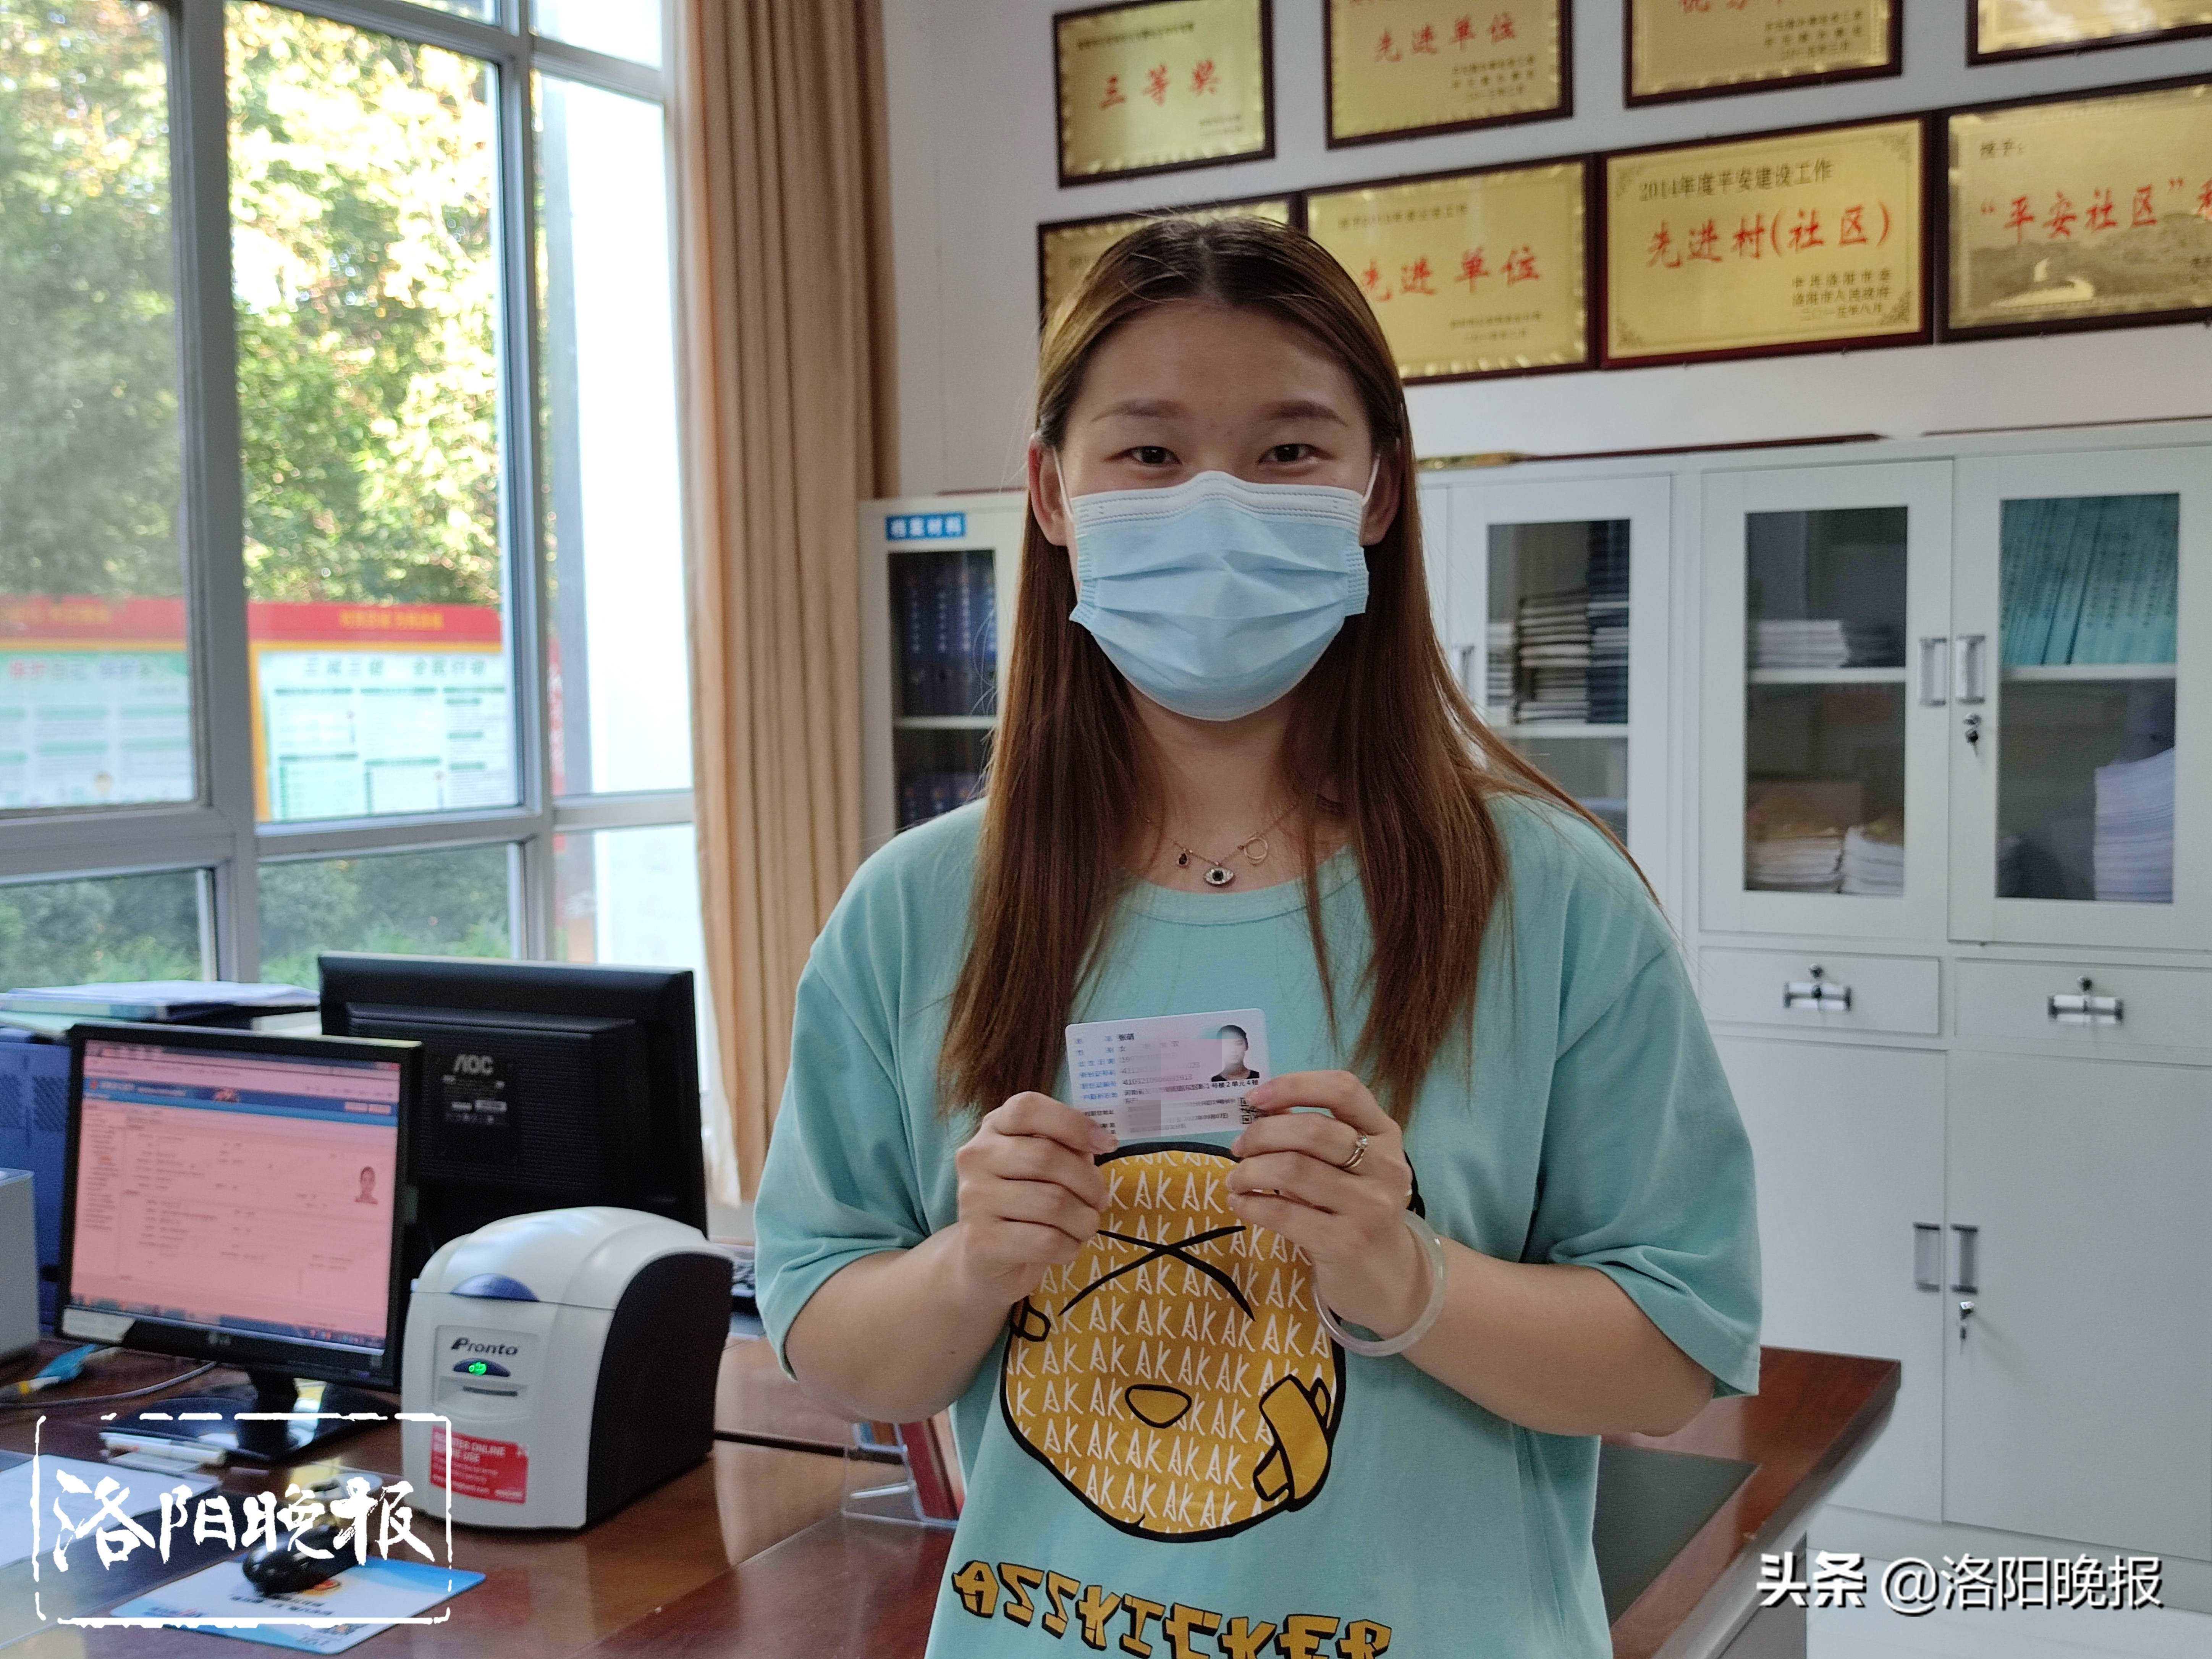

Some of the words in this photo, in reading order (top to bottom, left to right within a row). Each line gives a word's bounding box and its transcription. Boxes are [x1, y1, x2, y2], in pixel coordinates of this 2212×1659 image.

[1646, 200, 1891, 269] 先进村(社区)
[454, 1054, 494, 1075] AOC
[451, 1337, 519, 1356] Pronto
